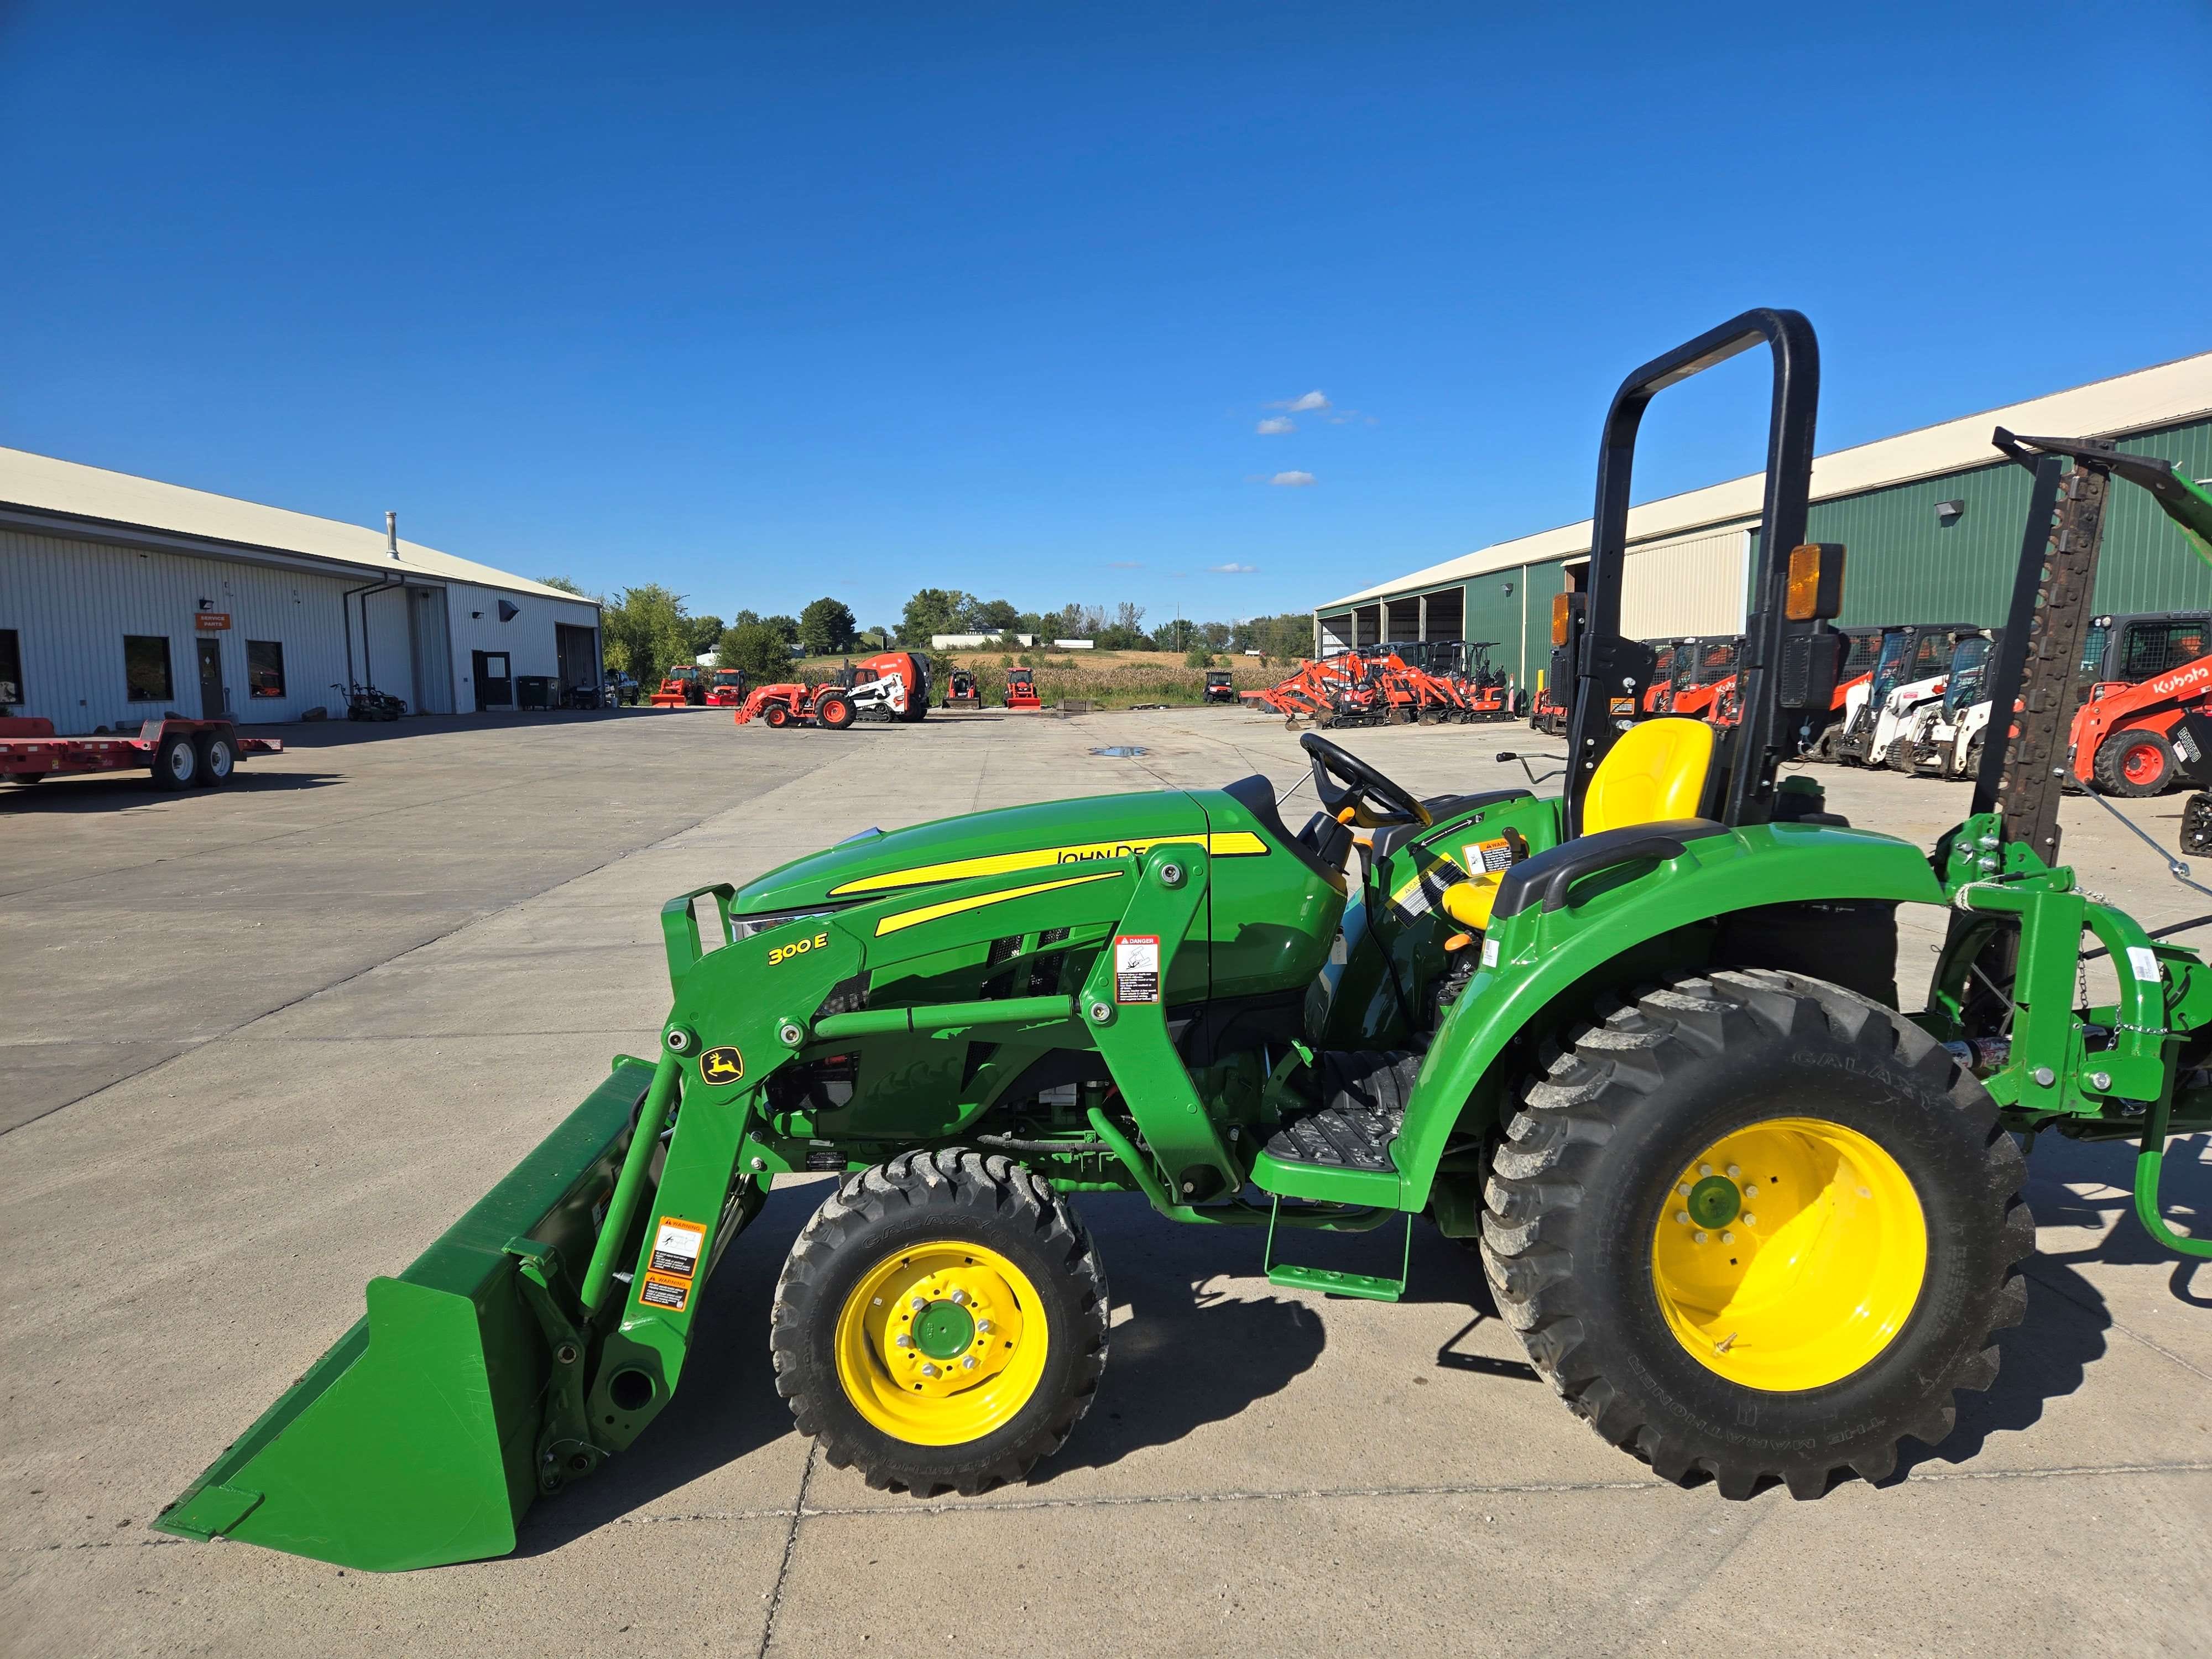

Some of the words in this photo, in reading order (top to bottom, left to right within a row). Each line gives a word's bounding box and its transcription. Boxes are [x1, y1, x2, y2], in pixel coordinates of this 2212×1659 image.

[1715, 681, 1736, 693] Kub
[2152, 667, 2209, 694] Kubota
[2177, 726, 2202, 763] BARRETO
[1057, 849, 1110, 864] JOHN
[1408, 867, 1434, 891] CAUTION
[768, 938, 812, 966] 300
[814, 932, 828, 950] E
[672, 1220, 701, 1232] WARNING
[862, 1214, 992, 1249] GALAXY
[658, 1277, 686, 1287] WARNING
[1627, 1353, 1816, 1451] MARATHONER
[1827, 1415, 1888, 1446] THE
